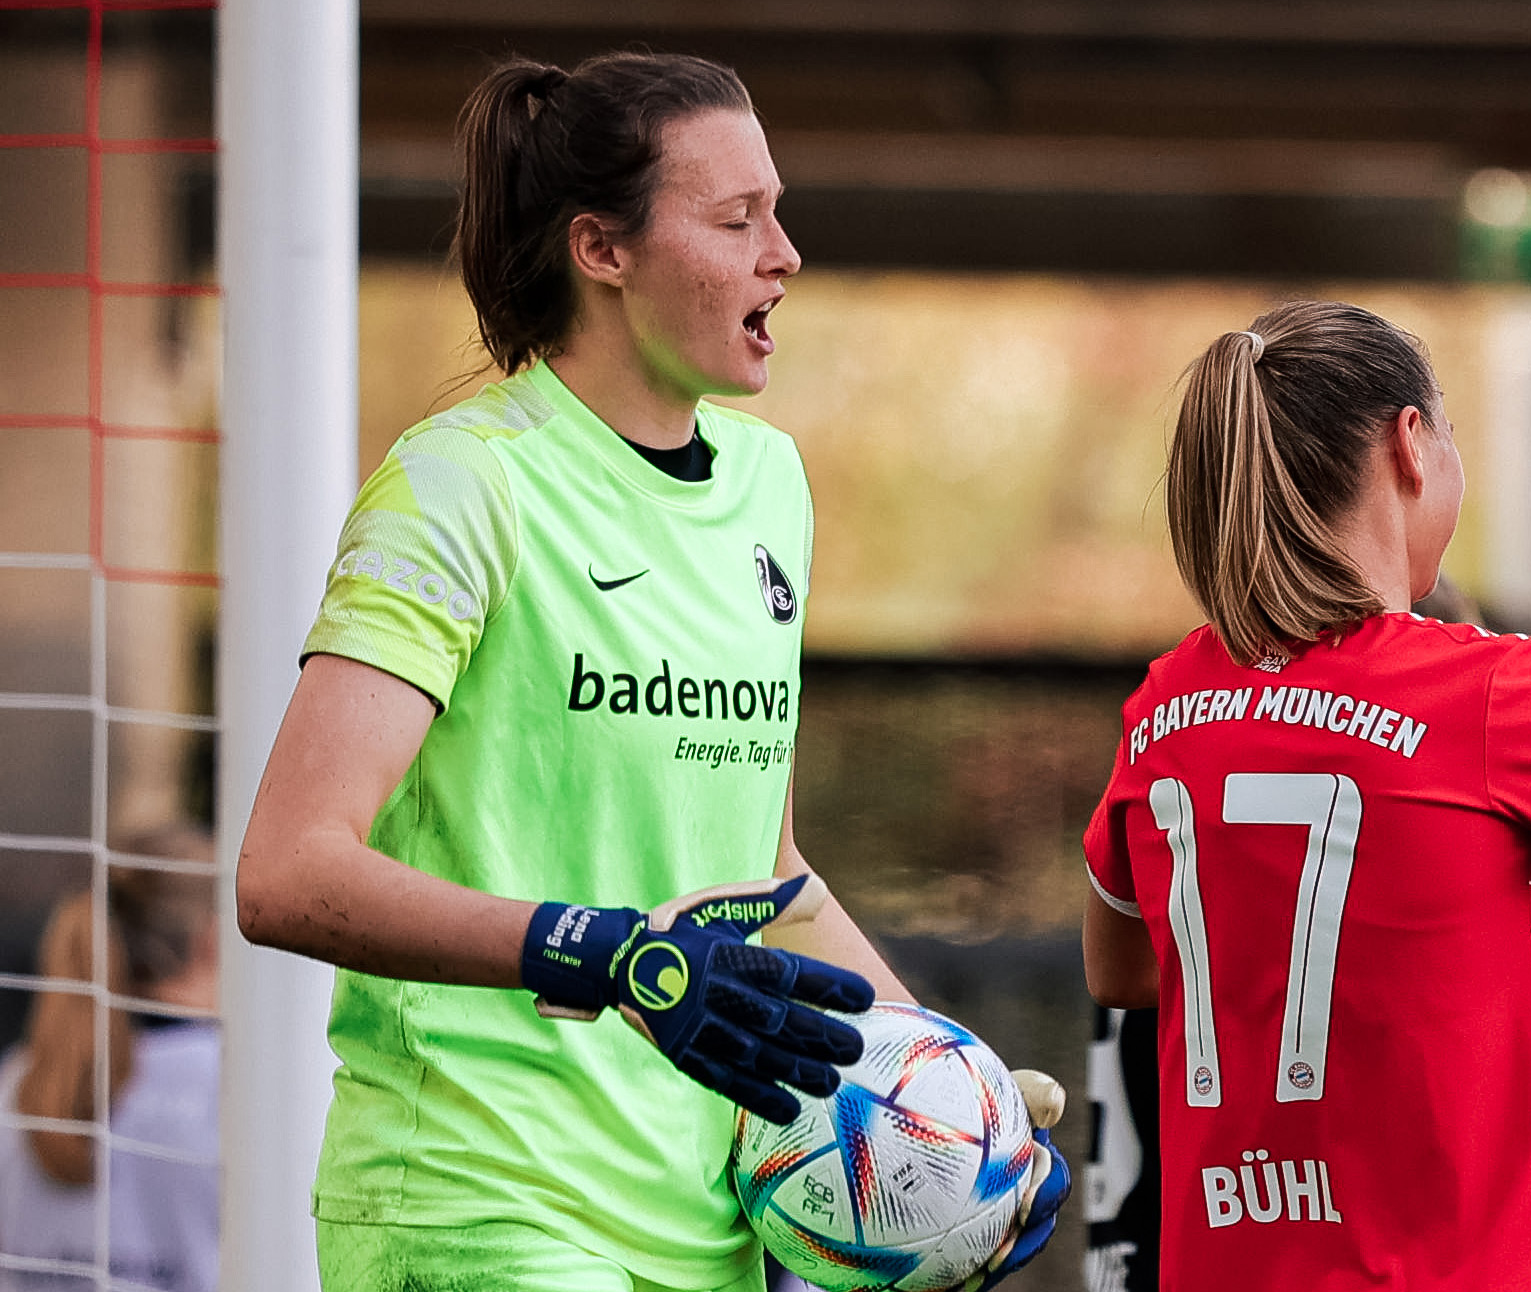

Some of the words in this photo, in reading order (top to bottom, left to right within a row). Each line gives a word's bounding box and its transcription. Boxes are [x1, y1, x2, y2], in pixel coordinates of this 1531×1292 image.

[335, 549, 474, 621] CAZOO
[567, 652, 789, 723] badenova
[1129, 717, 1149, 766] FC
[1152, 687, 1254, 743] BAYERN
[1253, 685, 1428, 759] MÜNCHEN
[674, 736, 743, 770] Energie.
[747, 740, 772, 771] Tag
[1149, 773, 1362, 1108] 17
[1201, 1149, 1343, 1229] BÜHL
